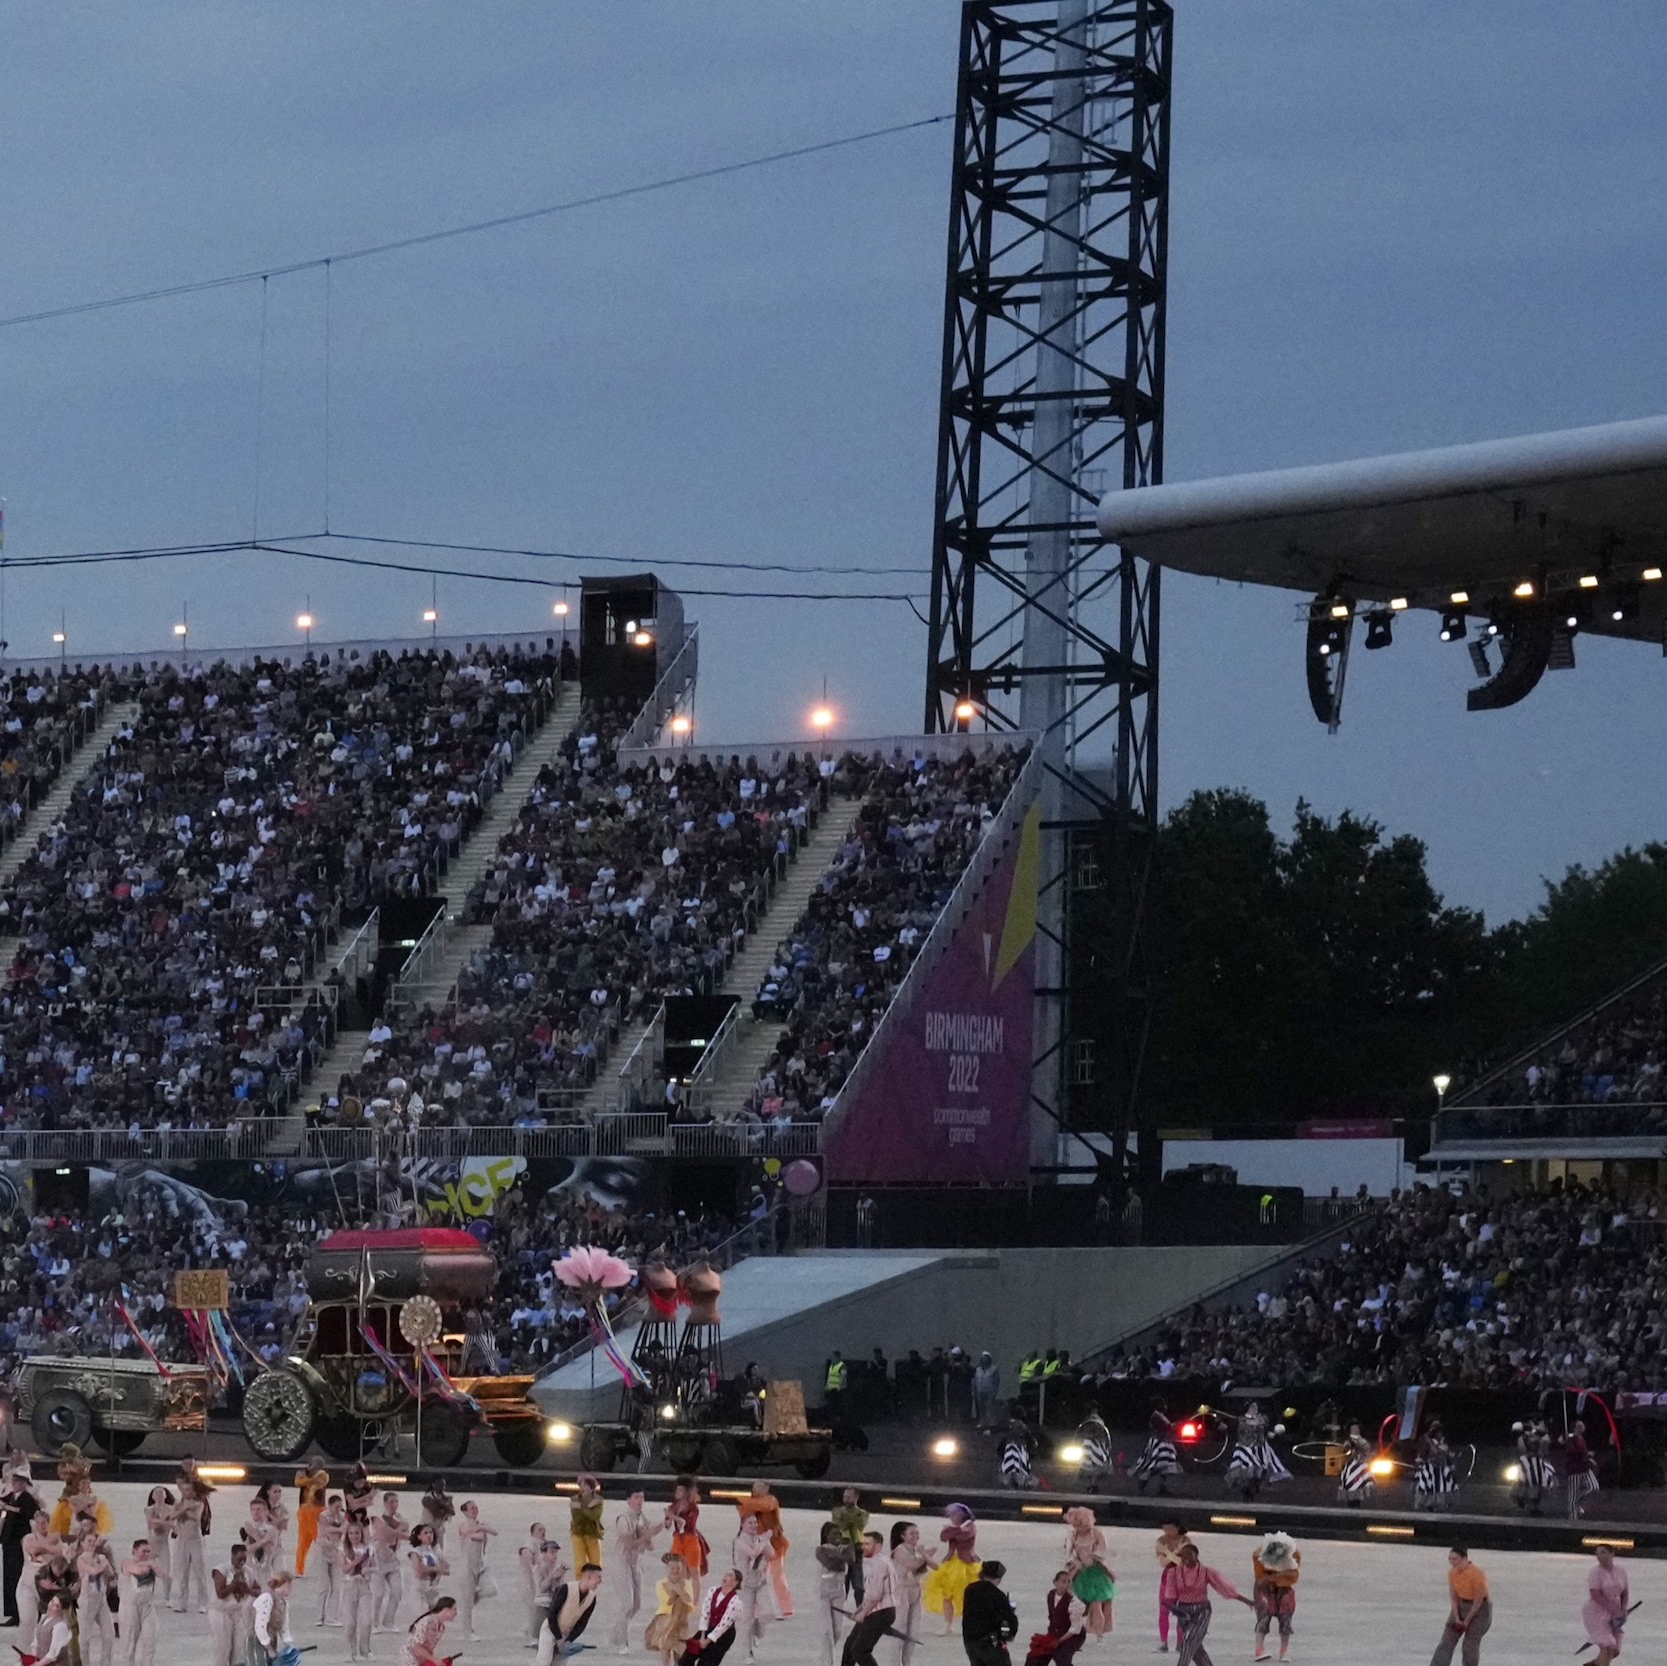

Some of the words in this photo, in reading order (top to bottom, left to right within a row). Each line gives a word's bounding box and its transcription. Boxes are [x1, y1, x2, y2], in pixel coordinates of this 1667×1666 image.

[925, 1013, 1003, 1053] BIRMINGHAM
[948, 1055, 980, 1093] 2022
[934, 1107, 990, 1125] commonwealth
[949, 1128, 976, 1148] games
